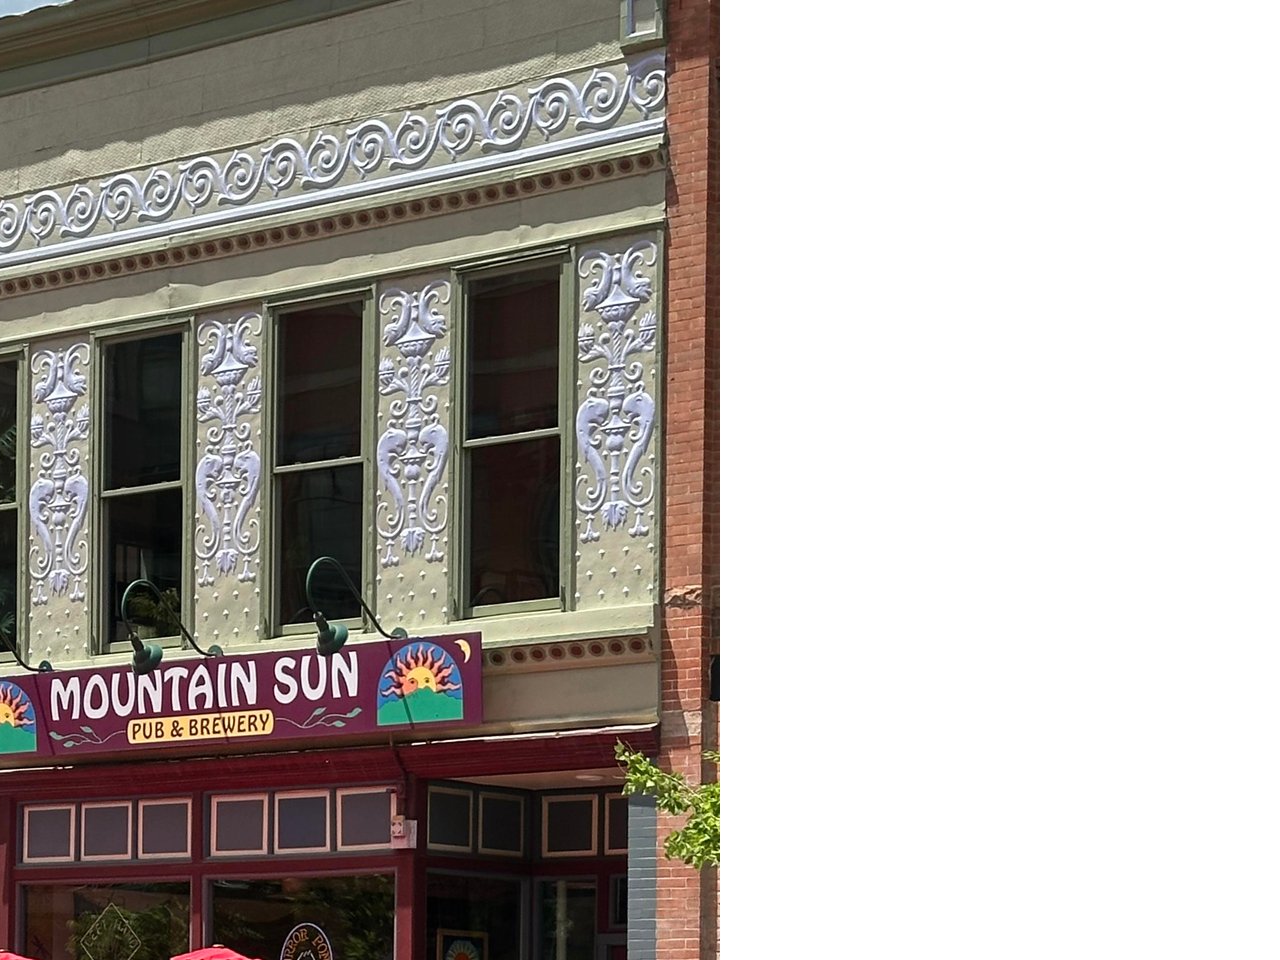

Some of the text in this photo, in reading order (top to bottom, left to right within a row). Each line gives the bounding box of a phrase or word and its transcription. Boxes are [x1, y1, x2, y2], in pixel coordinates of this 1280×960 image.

[50, 651, 359, 721] MOUNTAIN SUN
[132, 713, 270, 740] PUB & BREWERY
